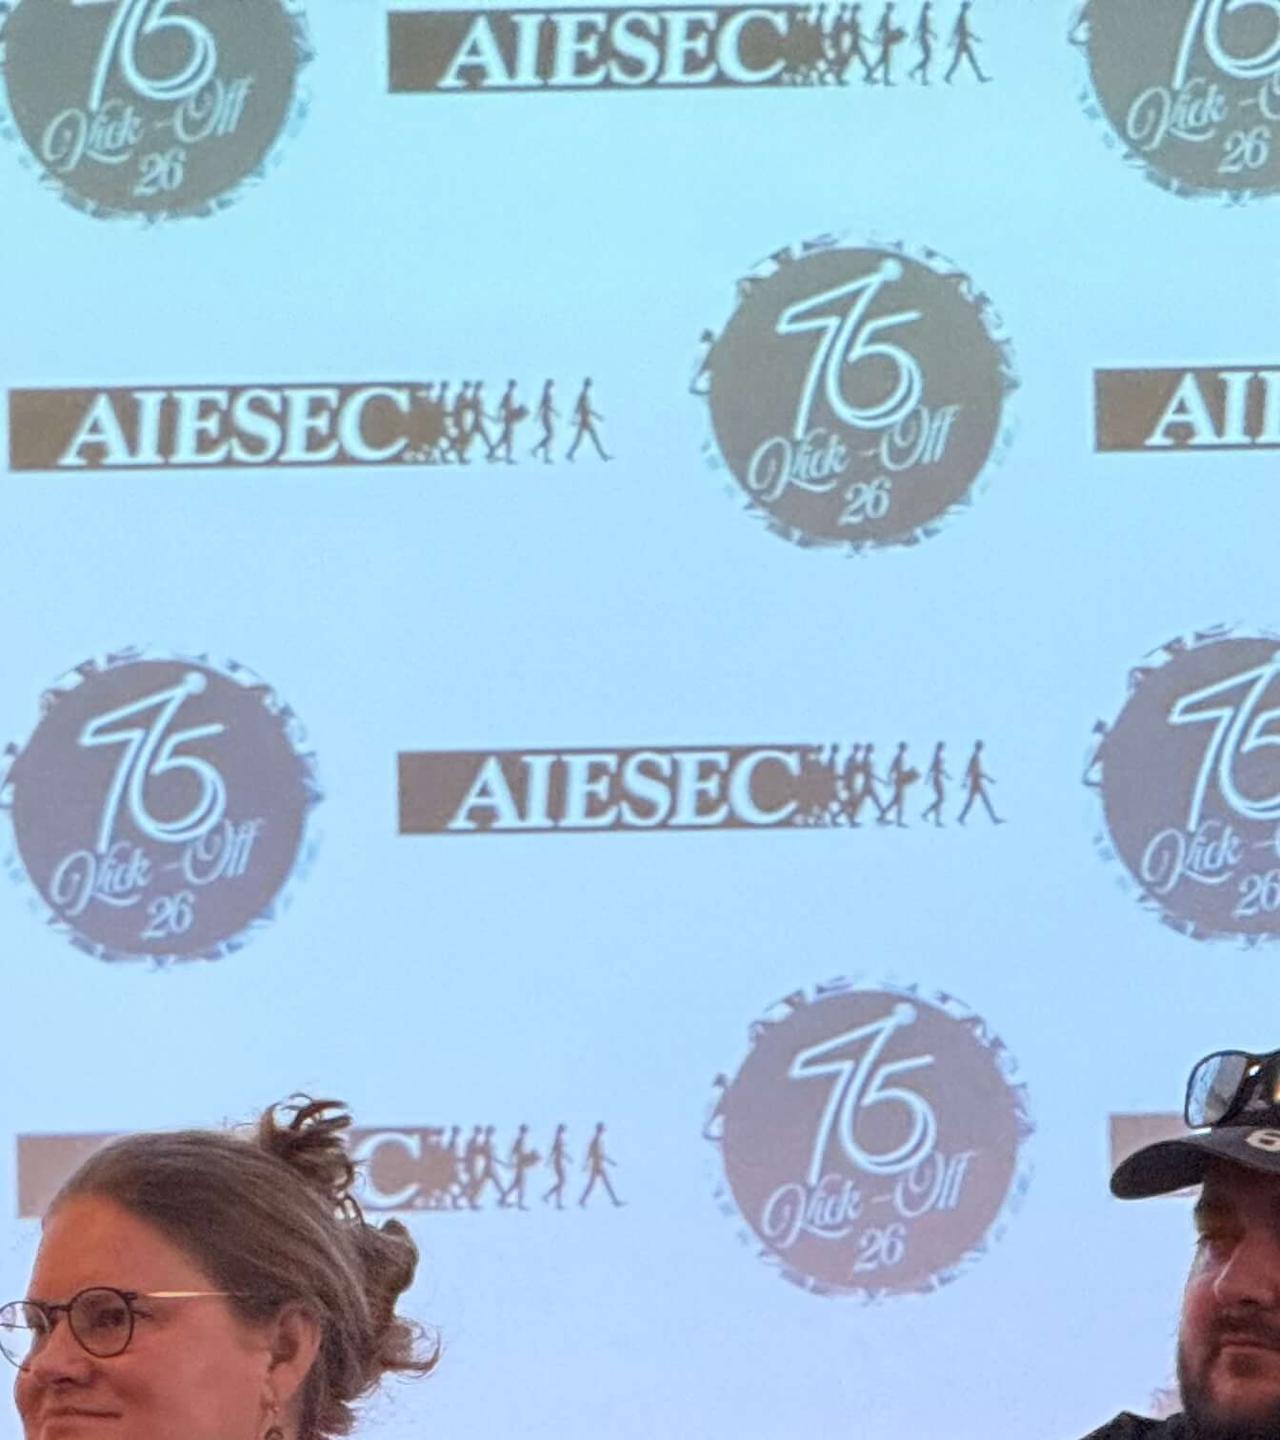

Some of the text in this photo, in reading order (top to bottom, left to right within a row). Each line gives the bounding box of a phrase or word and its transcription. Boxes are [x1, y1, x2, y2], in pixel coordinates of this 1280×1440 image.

[436, 9, 789, 88] AIESEC
[132, 149, 187, 196] 26
[1216, 125, 1272, 173] 26
[55, 386, 412, 466] AIESEC
[838, 475, 892, 525] 26
[447, 750, 801, 831] AIESEC
[140, 890, 195, 940] 26
[1230, 868, 1280, 918] 26
[851, 1222, 907, 1274] 26
